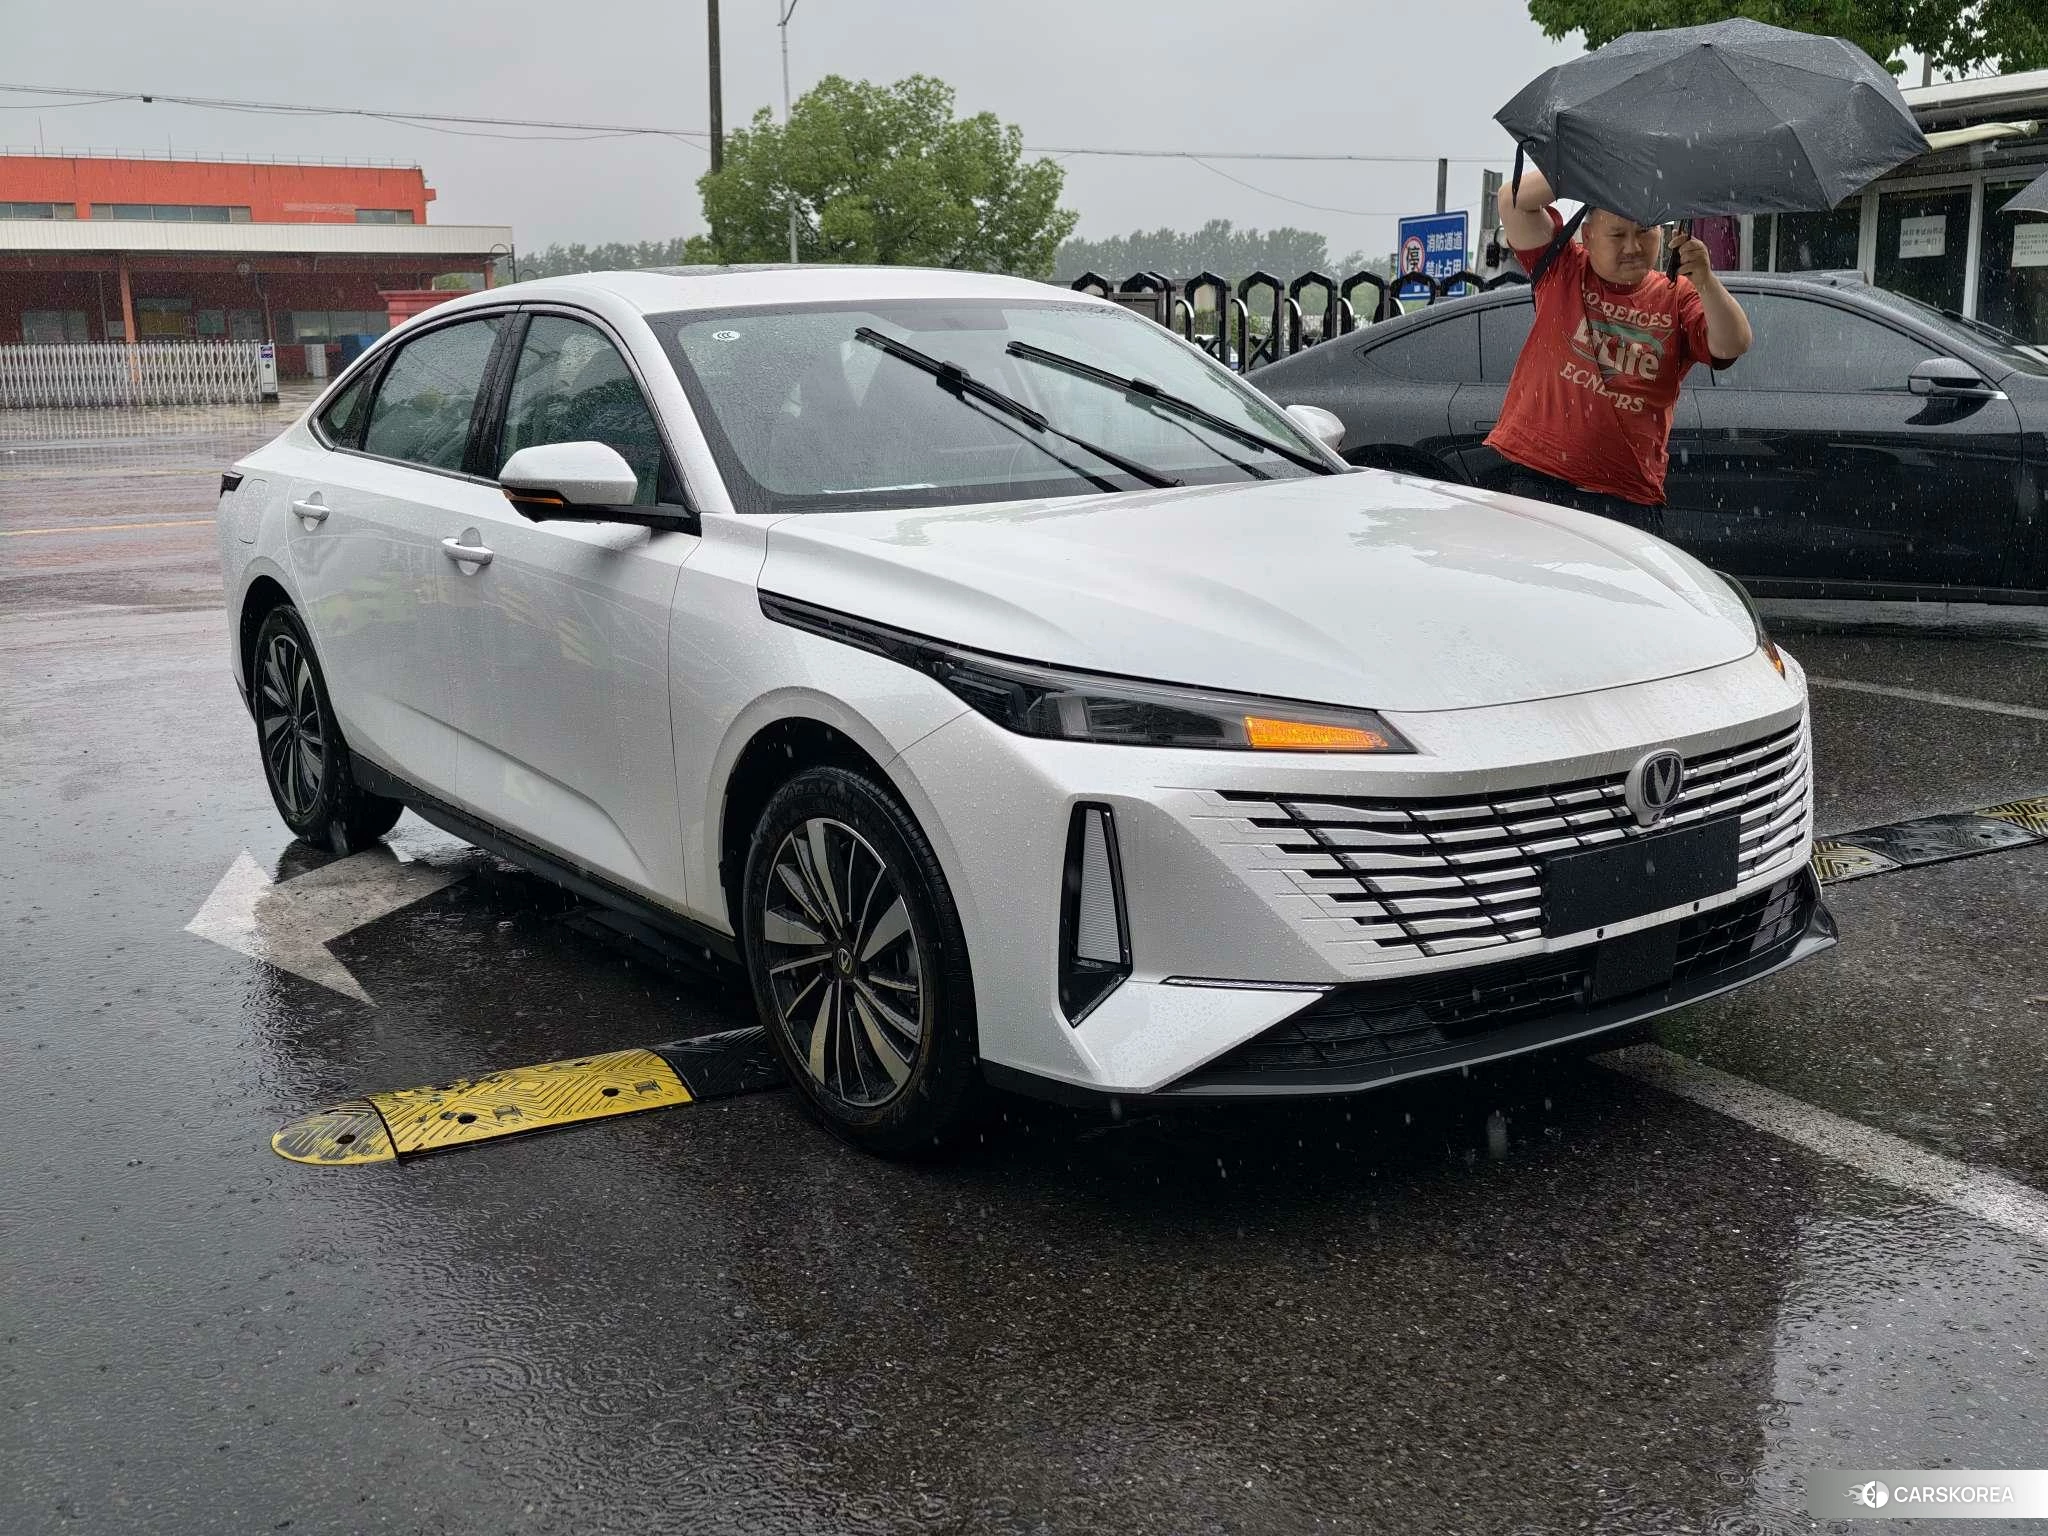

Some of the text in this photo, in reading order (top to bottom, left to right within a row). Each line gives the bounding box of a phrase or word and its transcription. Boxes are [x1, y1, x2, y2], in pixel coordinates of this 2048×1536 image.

[1427, 231, 1462, 252] 消防通道
[1426, 259, 1461, 278] 禁止占用
